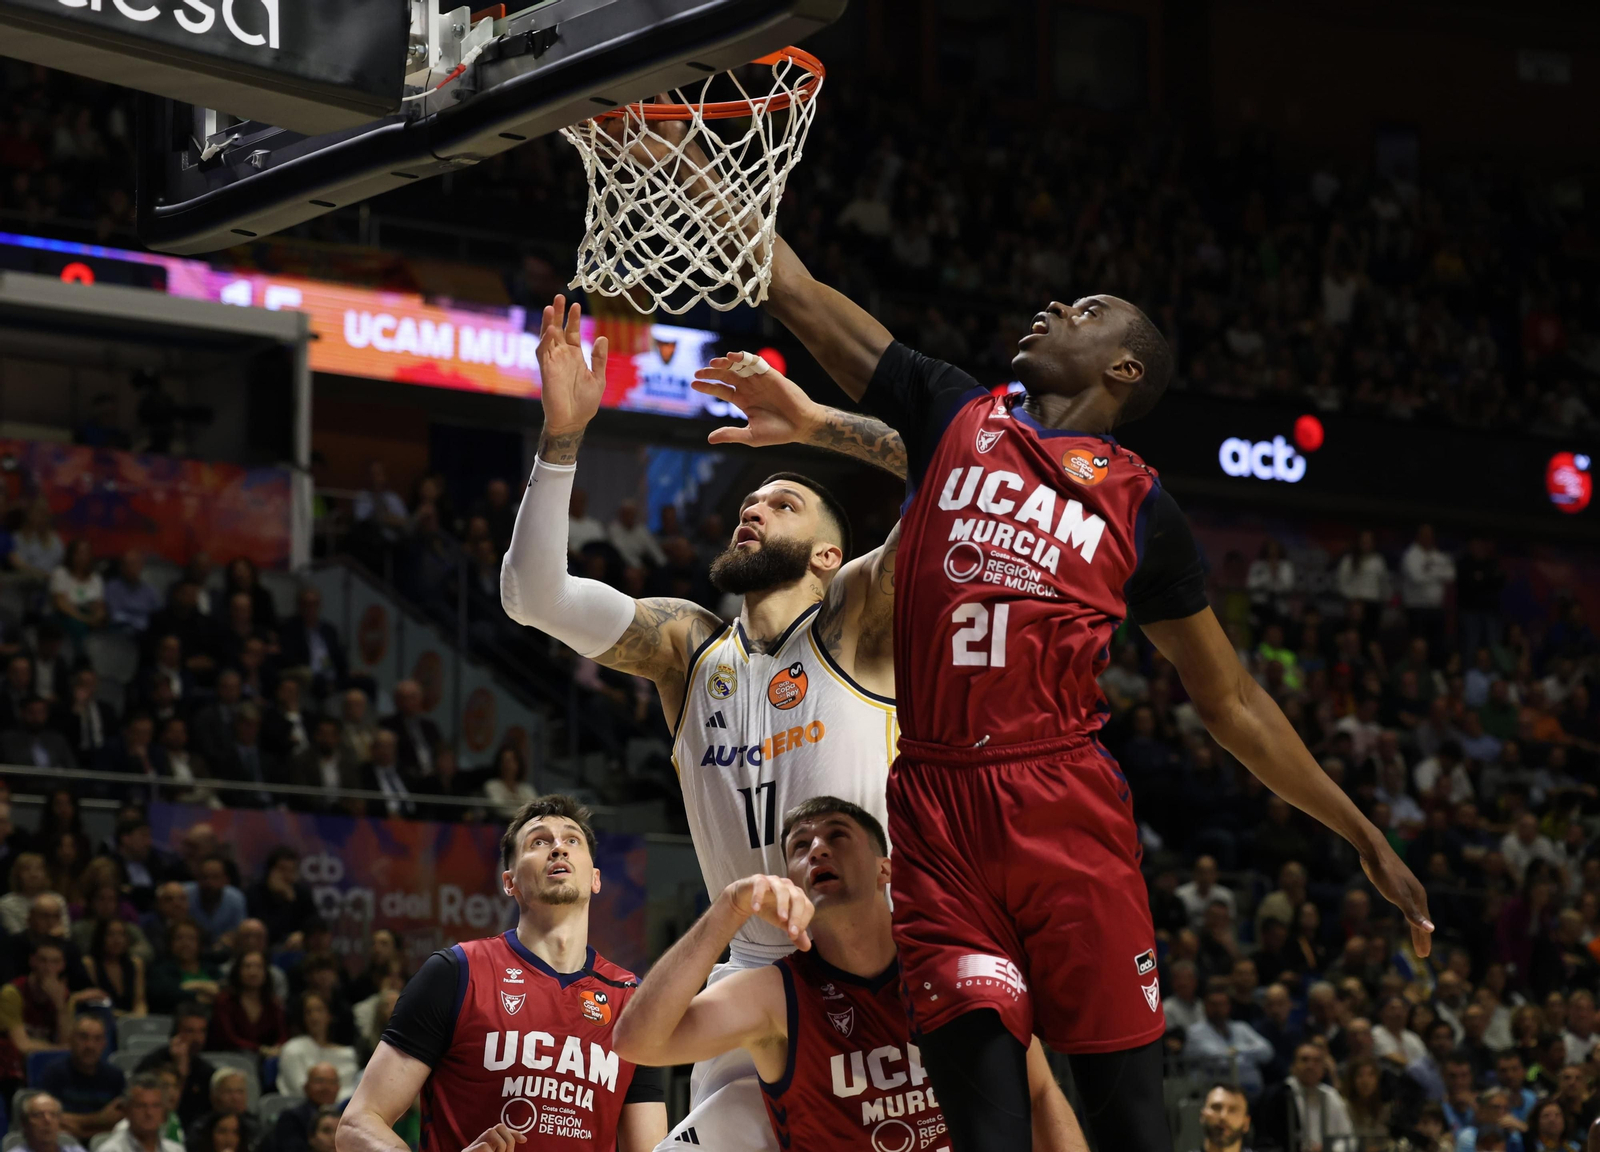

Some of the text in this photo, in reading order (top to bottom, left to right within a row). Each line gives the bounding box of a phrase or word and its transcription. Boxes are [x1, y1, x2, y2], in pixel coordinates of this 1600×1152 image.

[58, 0, 280, 50] sa
[344, 309, 541, 371] UCAM MUR
[1218, 435, 1307, 484] acb
[938, 466, 1106, 564] UCAM
[948, 518, 1060, 575] MURCIA
[990, 550, 1010, 560] Costa
[982, 571, 1058, 598] DE MURCIA
[986, 559, 1042, 582] REGIÓN
[951, 602, 1010, 667] 21
[775, 683, 796, 695] Copa
[700, 720, 826, 767] AUTOHERO
[737, 780, 777, 849] 17
[301, 851, 345, 884] cb
[438, 883, 515, 932] Rey
[1140, 959, 1153, 972] acb
[956, 979, 1019, 1002] SOLUTIONS
[483, 1031, 619, 1093] UCAM
[830, 1042, 928, 1098] UCA
[501, 1076, 594, 1112] MURCIA
[542, 1104, 559, 1112] Costa
[861, 1087, 939, 1126] MURC
[538, 1123, 592, 1140] DE MURCIA
[540, 1113, 582, 1128] REGIÓN
[916, 1117, 936, 1126] Costa
[918, 1123, 948, 1139] REG
